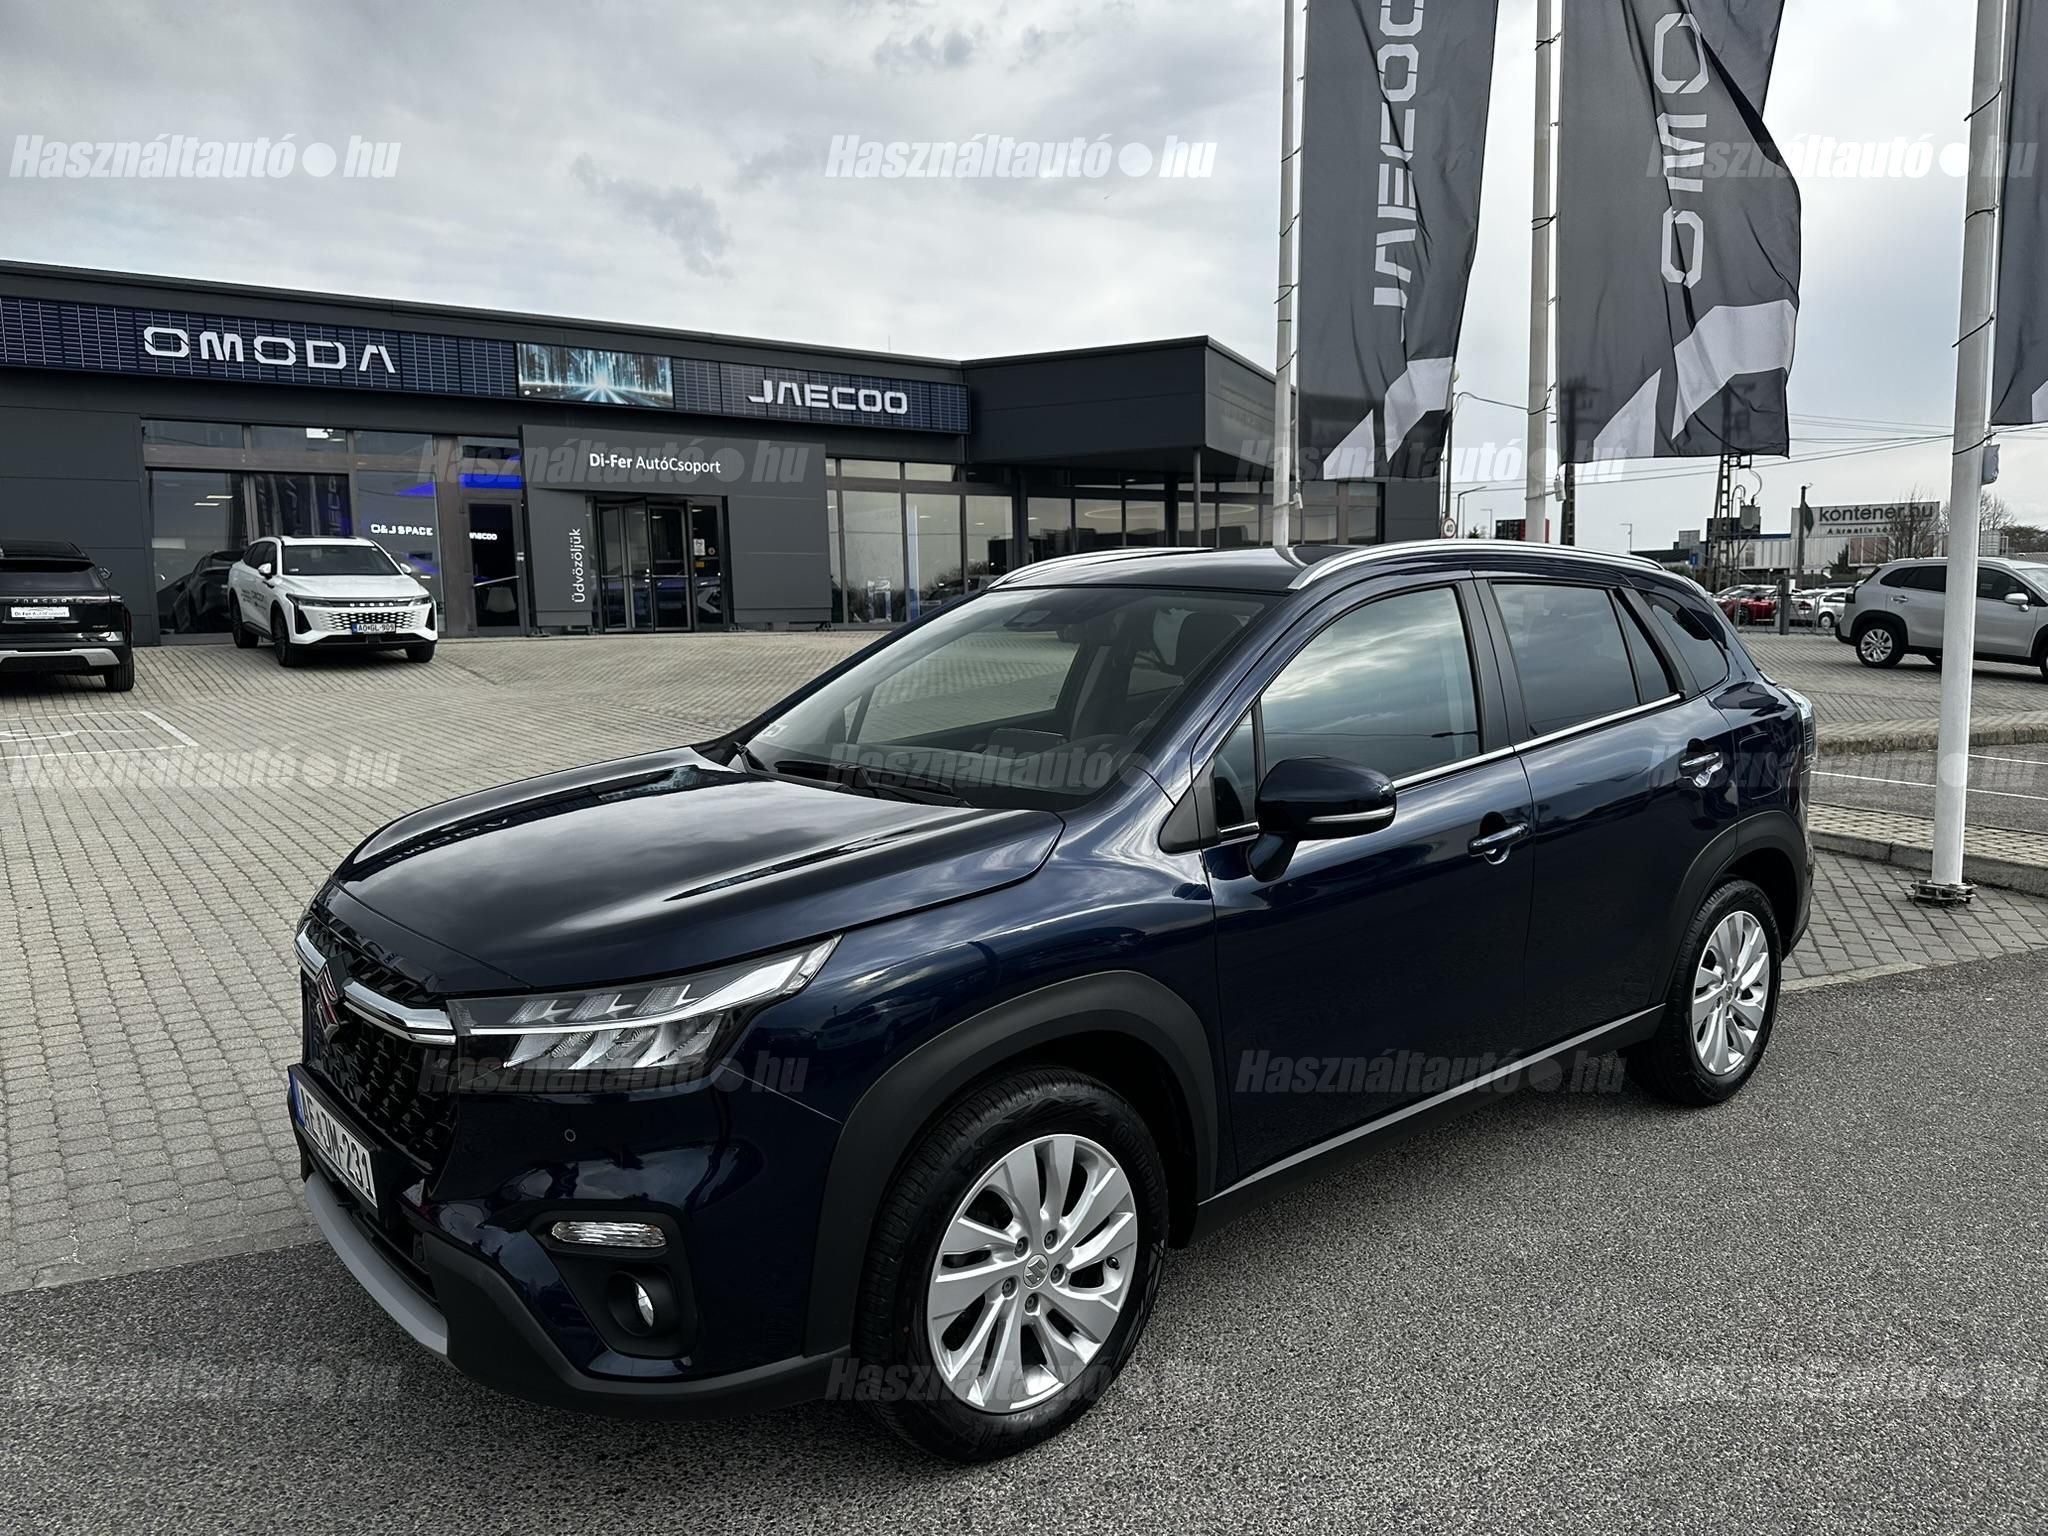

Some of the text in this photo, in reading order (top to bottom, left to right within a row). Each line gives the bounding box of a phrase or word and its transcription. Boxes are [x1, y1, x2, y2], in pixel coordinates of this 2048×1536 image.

[143, 326, 396, 373] OMODA
[748, 380, 908, 414] JAECOO
[589, 453, 721, 474] Di-Fer AutóCsoport
[398, 526, 433, 536] SPACE
[569, 528, 586, 603] Üdvözöljük
